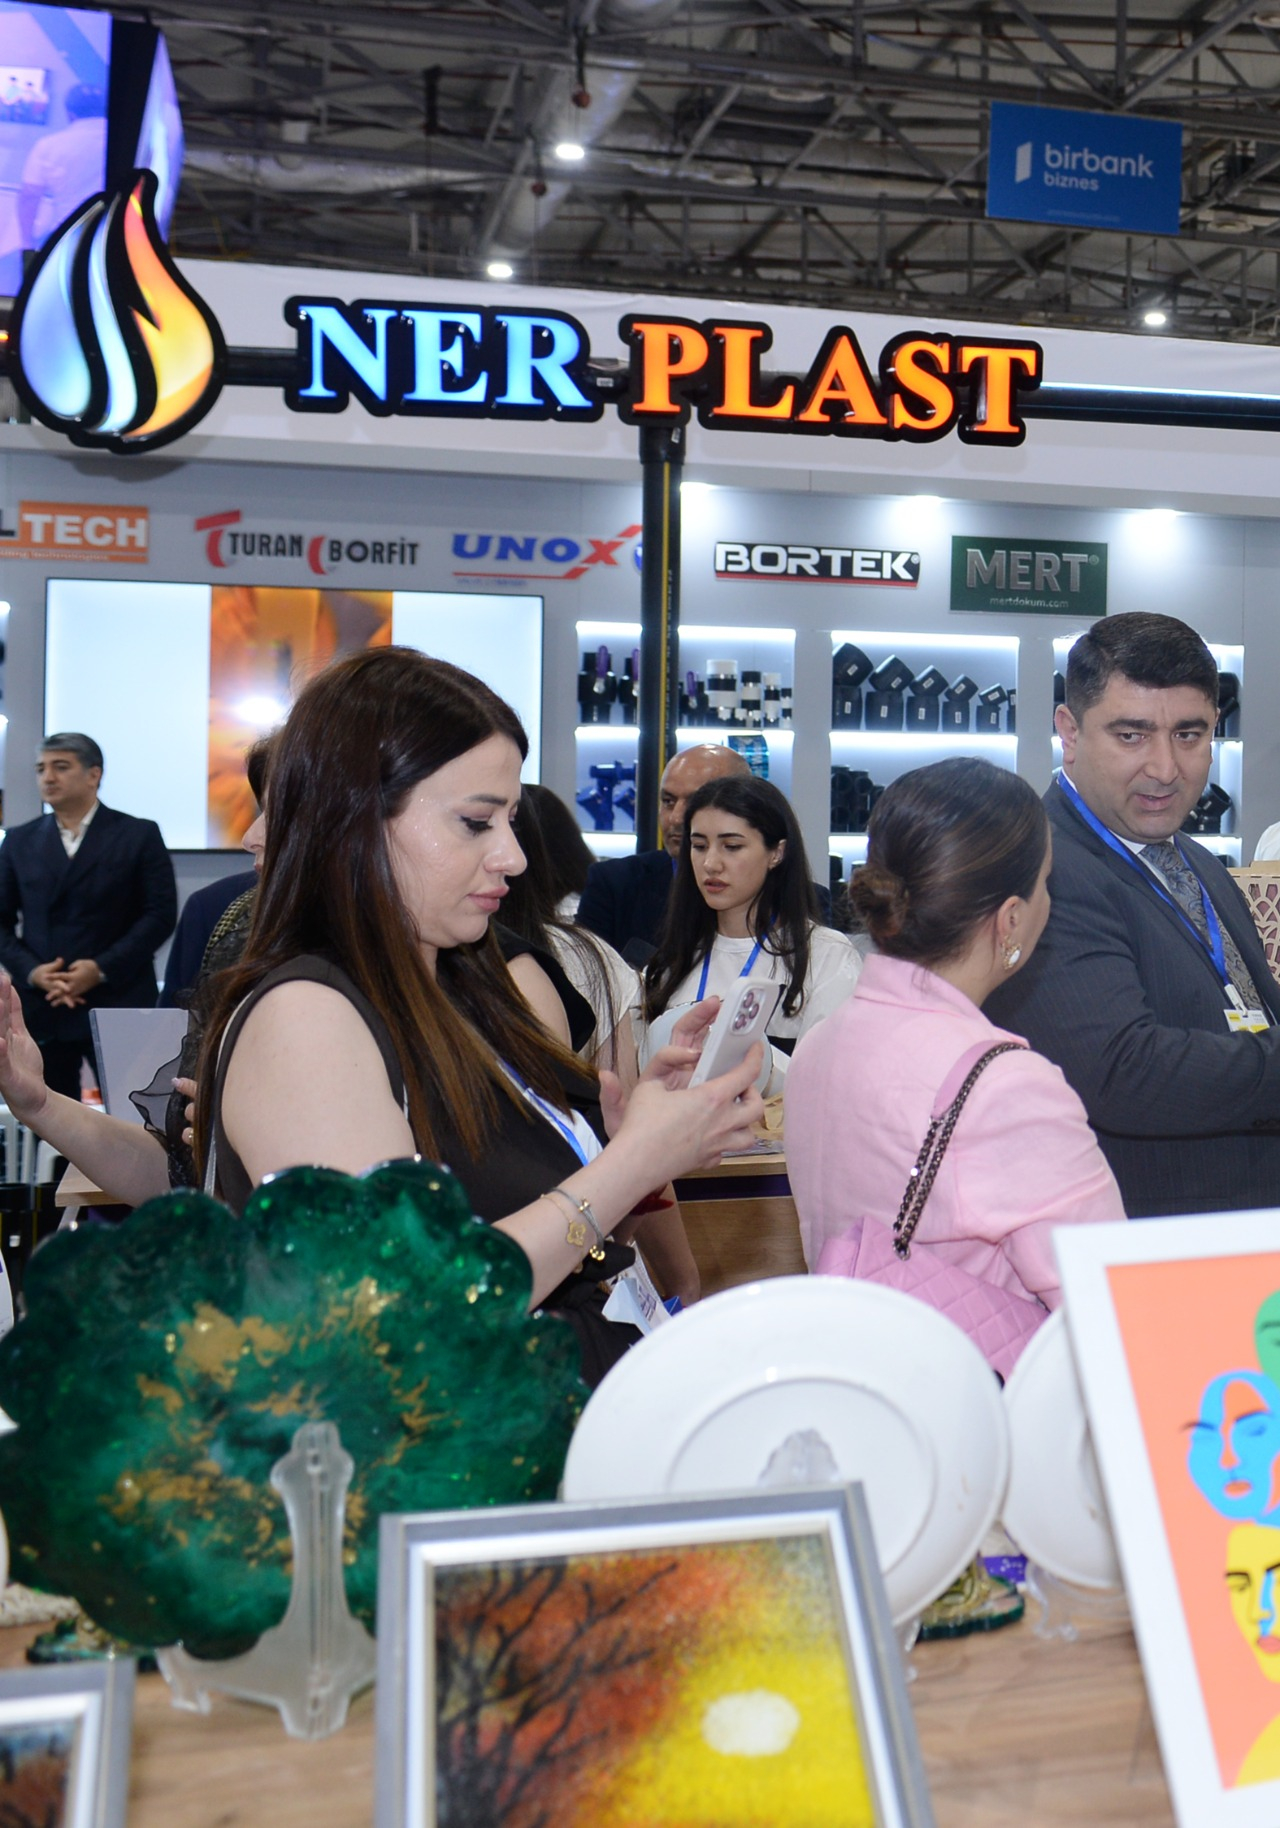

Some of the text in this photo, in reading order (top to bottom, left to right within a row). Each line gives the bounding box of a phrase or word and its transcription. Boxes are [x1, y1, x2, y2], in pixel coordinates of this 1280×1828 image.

[1044, 143, 1154, 178] birbank
[1043, 171, 1100, 191] biznes
[299, 305, 1037, 434] NER PLAST
[228, 532, 304, 557] TURAN
[453, 534, 626, 566] UNOX
[966, 548, 1089, 593] MERT
